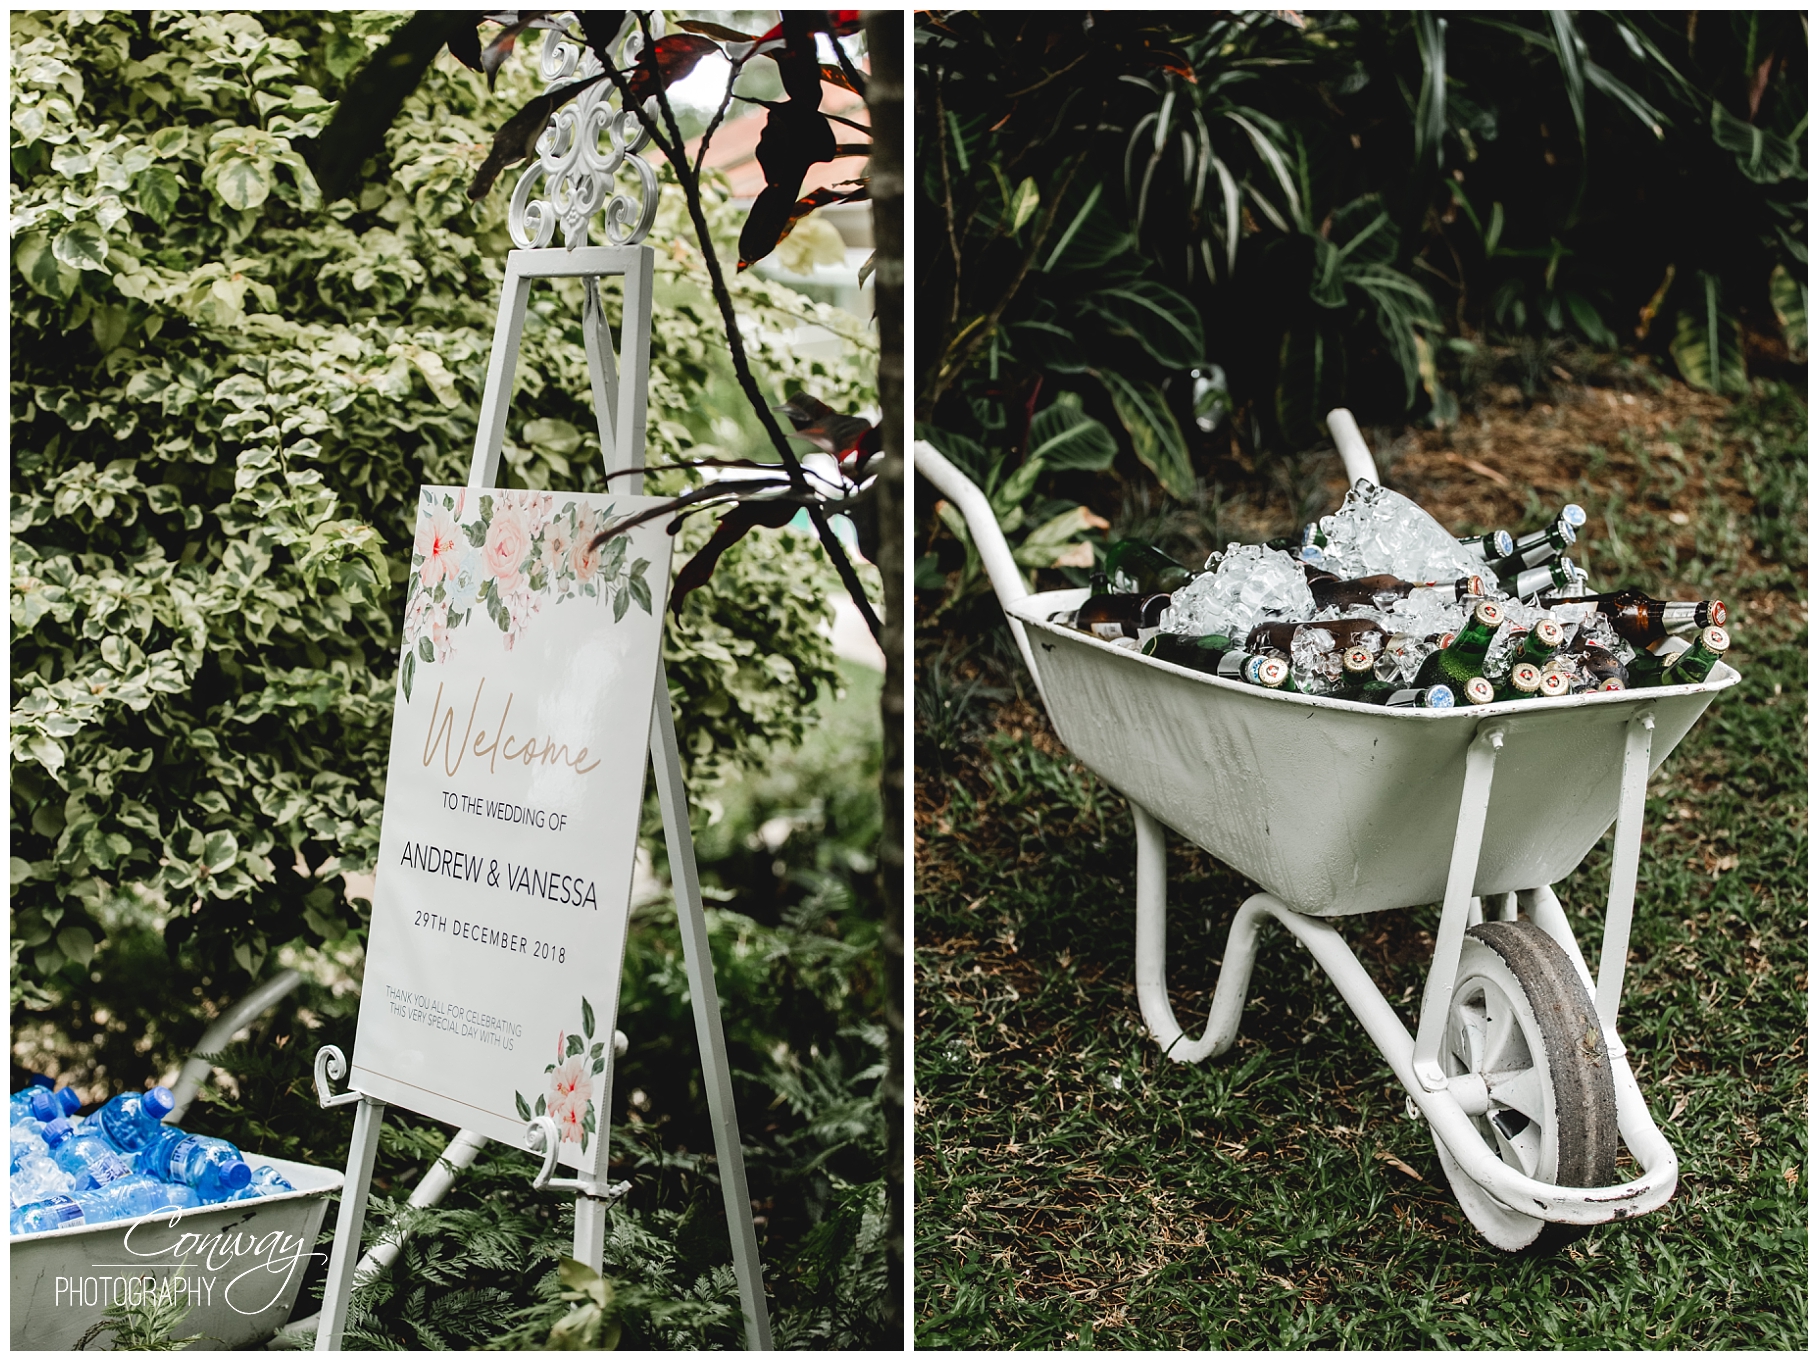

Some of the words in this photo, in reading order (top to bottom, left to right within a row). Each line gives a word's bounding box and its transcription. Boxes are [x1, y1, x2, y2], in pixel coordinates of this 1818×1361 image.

[423, 677, 601, 777] Welcome
[442, 791, 458, 810] TO
[461, 794, 483, 816] THE
[486, 800, 545, 828] WEDDING
[548, 812, 568, 832] OF
[400, 841, 484, 884] ANDREW
[486, 859, 501, 888] &
[507, 863, 598, 911] VANESSA
[414, 910, 447, 933] 29TH
[453, 919, 527, 954] DECEMBER
[533, 940, 566, 964] 2018
[385, 984, 413, 1004] THANK
[414, 993, 430, 1010] YOU
[431, 1000, 446, 1015] ALL
[447, 1004, 465, 1020] FOR
[466, 1009, 523, 1038] CELEBRATING
[389, 1001, 407, 1018] THIS
[408, 1007, 427, 1024] VERY
[428, 1013, 459, 1035] SPECIAL
[461, 1023, 479, 1040] DAY
[479, 1030, 501, 1047] WITH
[502, 1036, 514, 1051] US
